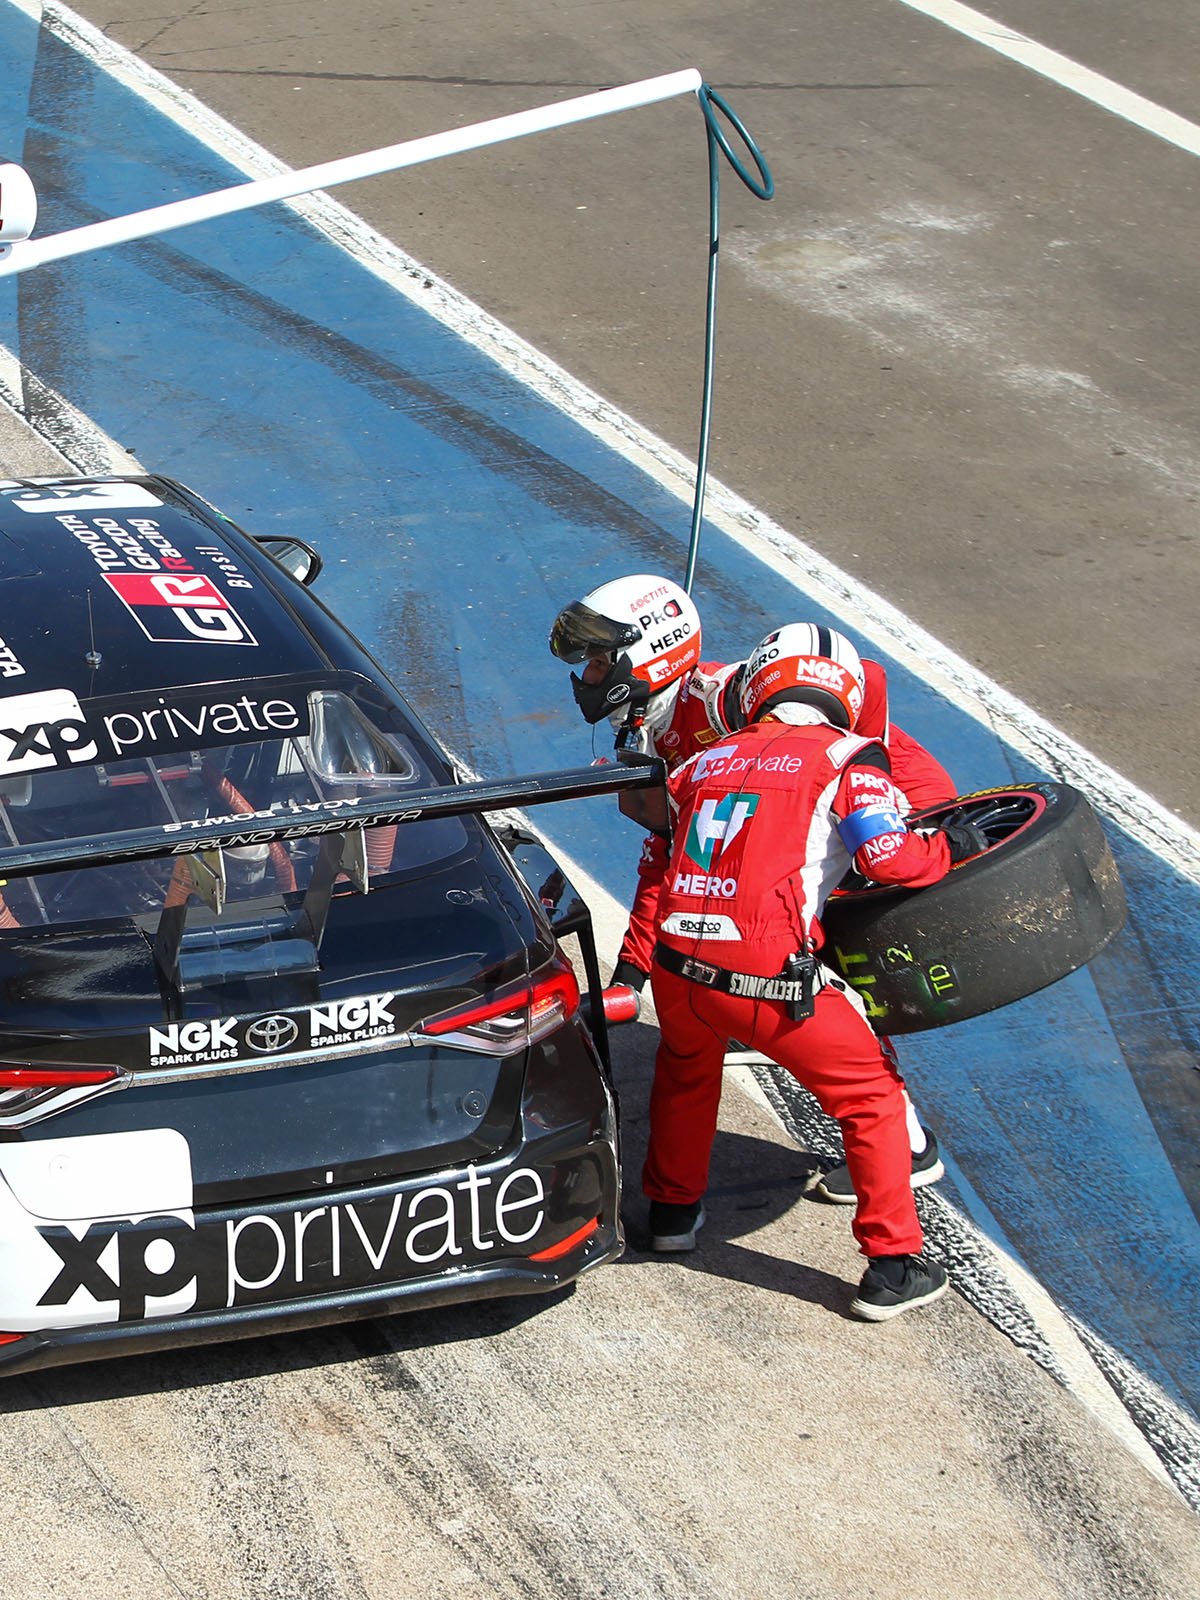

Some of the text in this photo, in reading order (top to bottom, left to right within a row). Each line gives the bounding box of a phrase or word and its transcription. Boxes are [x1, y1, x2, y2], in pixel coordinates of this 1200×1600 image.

[56, 514, 126, 571] TOYOTA
[92, 517, 161, 571] GAZOO
[127, 518, 195, 571] Racing
[195, 546, 254, 590] Brasil
[149, 575, 244, 641] GR
[630, 585, 669, 613] LOCTITE
[650, 622, 691, 654] HERO
[744, 648, 779, 684] HERO
[797, 658, 846, 687] NGK
[103, 694, 300, 756] private
[726, 753, 803, 775] private
[171, 831, 275, 854] BRUNO
[864, 832, 904, 859] NGK
[671, 873, 738, 898] HERO
[679, 919, 722, 934] sparco
[309, 991, 396, 1038] NGK
[149, 1016, 240, 1057] NGK
[310, 1024, 396, 1048] SPARK PLUGS
[150, 1048, 239, 1067] SPARK PLUGS
[225, 1163, 546, 1308] private
